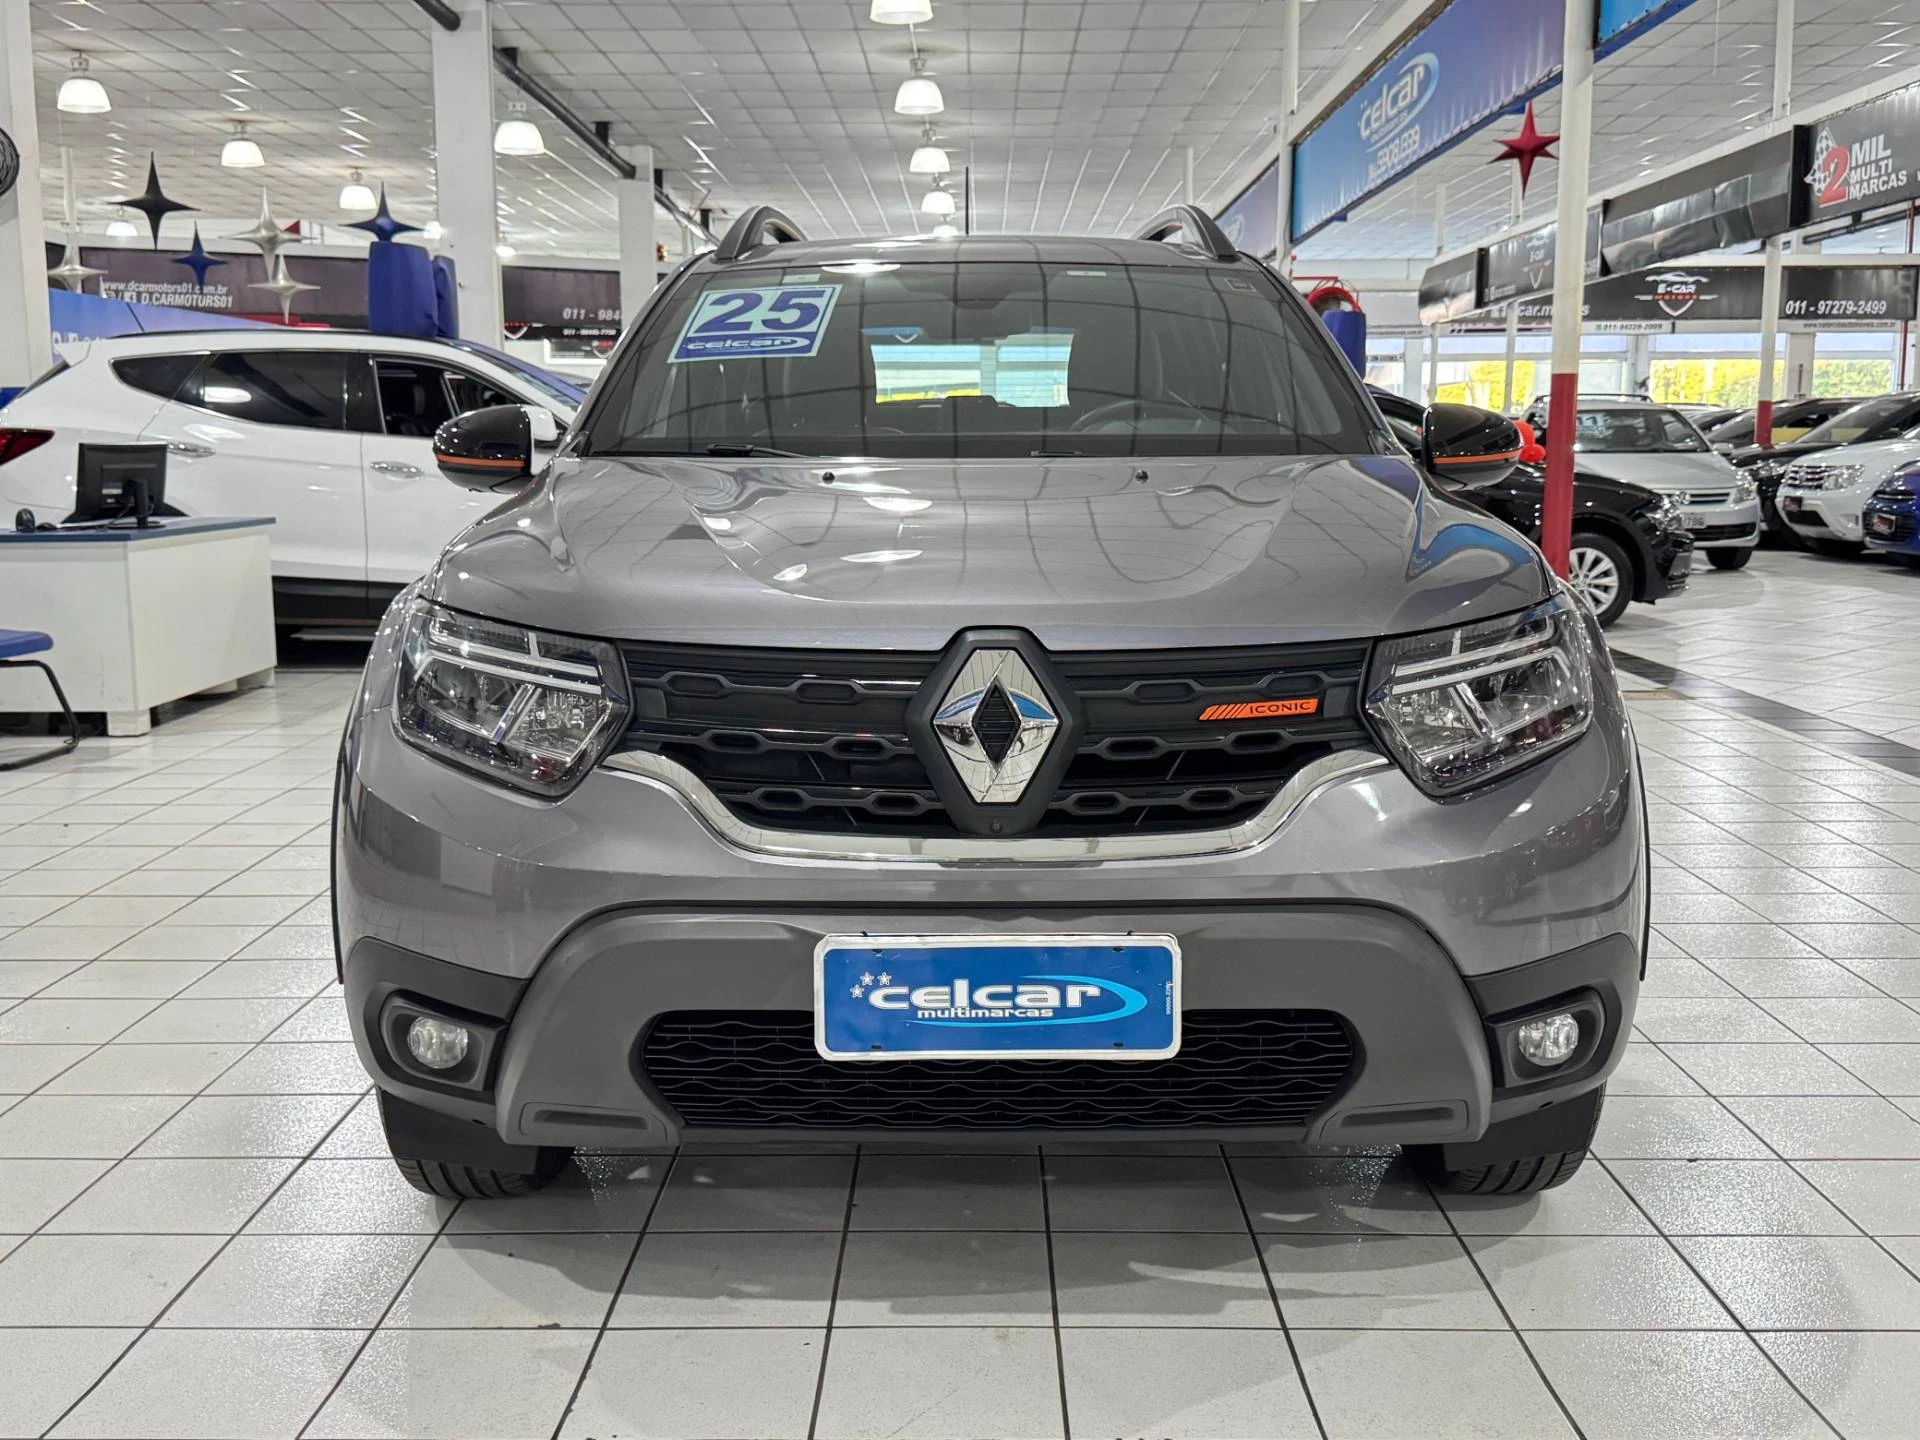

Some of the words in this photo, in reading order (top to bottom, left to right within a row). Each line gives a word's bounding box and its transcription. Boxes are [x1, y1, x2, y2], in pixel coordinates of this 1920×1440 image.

[1360, 63, 1424, 141] celcar
[1851, 134, 1892, 168] MIL
[1818, 145, 1850, 208] 2
[1849, 158, 1893, 184] MULTI
[1849, 170, 1908, 200] MARCAS
[104, 280, 228, 295] www.dcarmotors01.cm.br
[562, 307, 586, 320] 011
[693, 290, 826, 334] 25
[1785, 300, 1807, 314] 011
[1817, 300, 1887, 314] 97279-2499
[687, 338, 792, 350] celcar
[1250, 702, 1311, 714] ICONIC
[868, 978, 1101, 1009] celcar
[917, 1007, 1054, 1018] multimarcas
